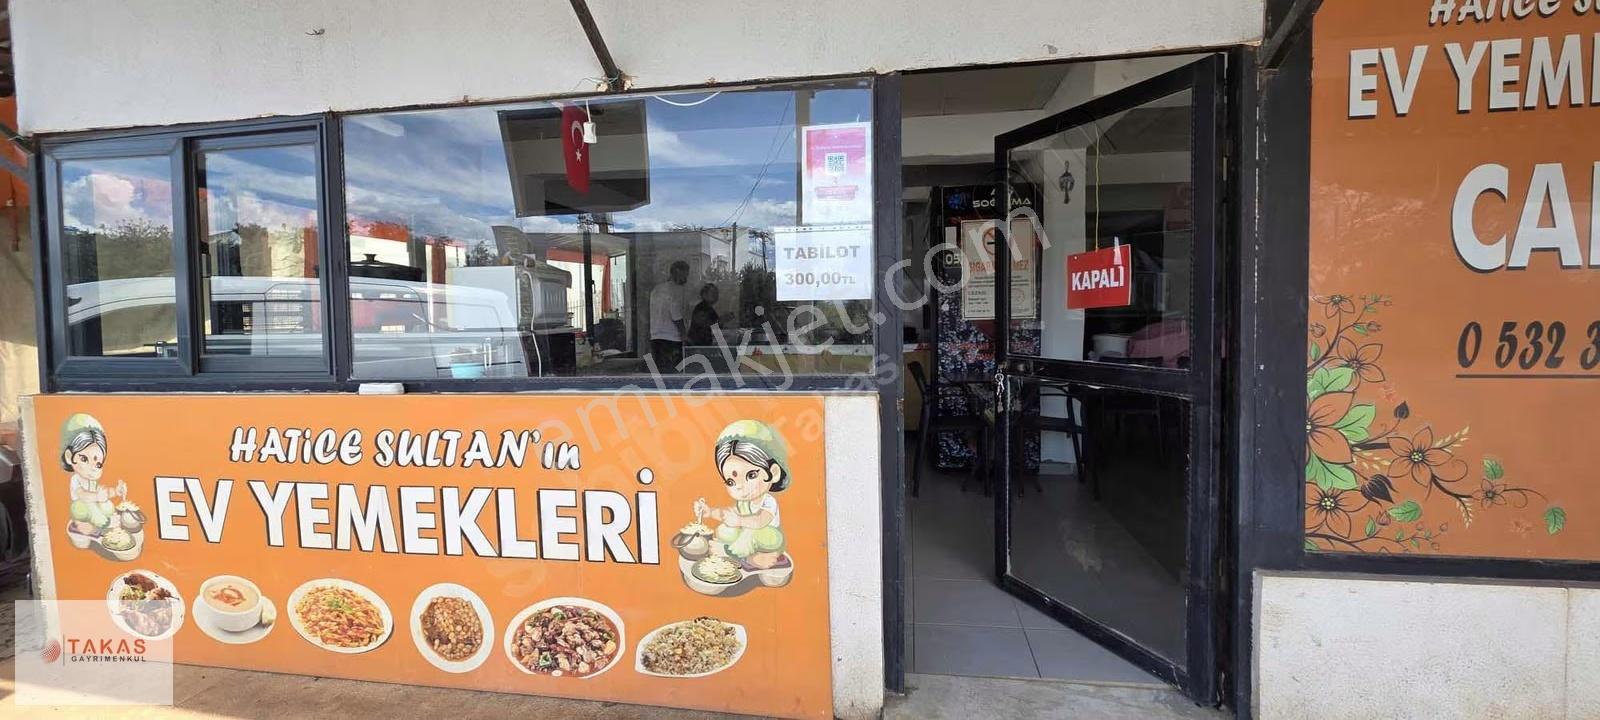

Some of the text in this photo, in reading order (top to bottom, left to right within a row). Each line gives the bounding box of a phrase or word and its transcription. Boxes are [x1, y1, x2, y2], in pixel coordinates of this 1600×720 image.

[1348, 46, 1429, 120] EV
[784, 245, 860, 259] TABİLOT
[1495, 321, 1567, 370] 532
[154, 467, 661, 565] EV YEMEKLERİ
